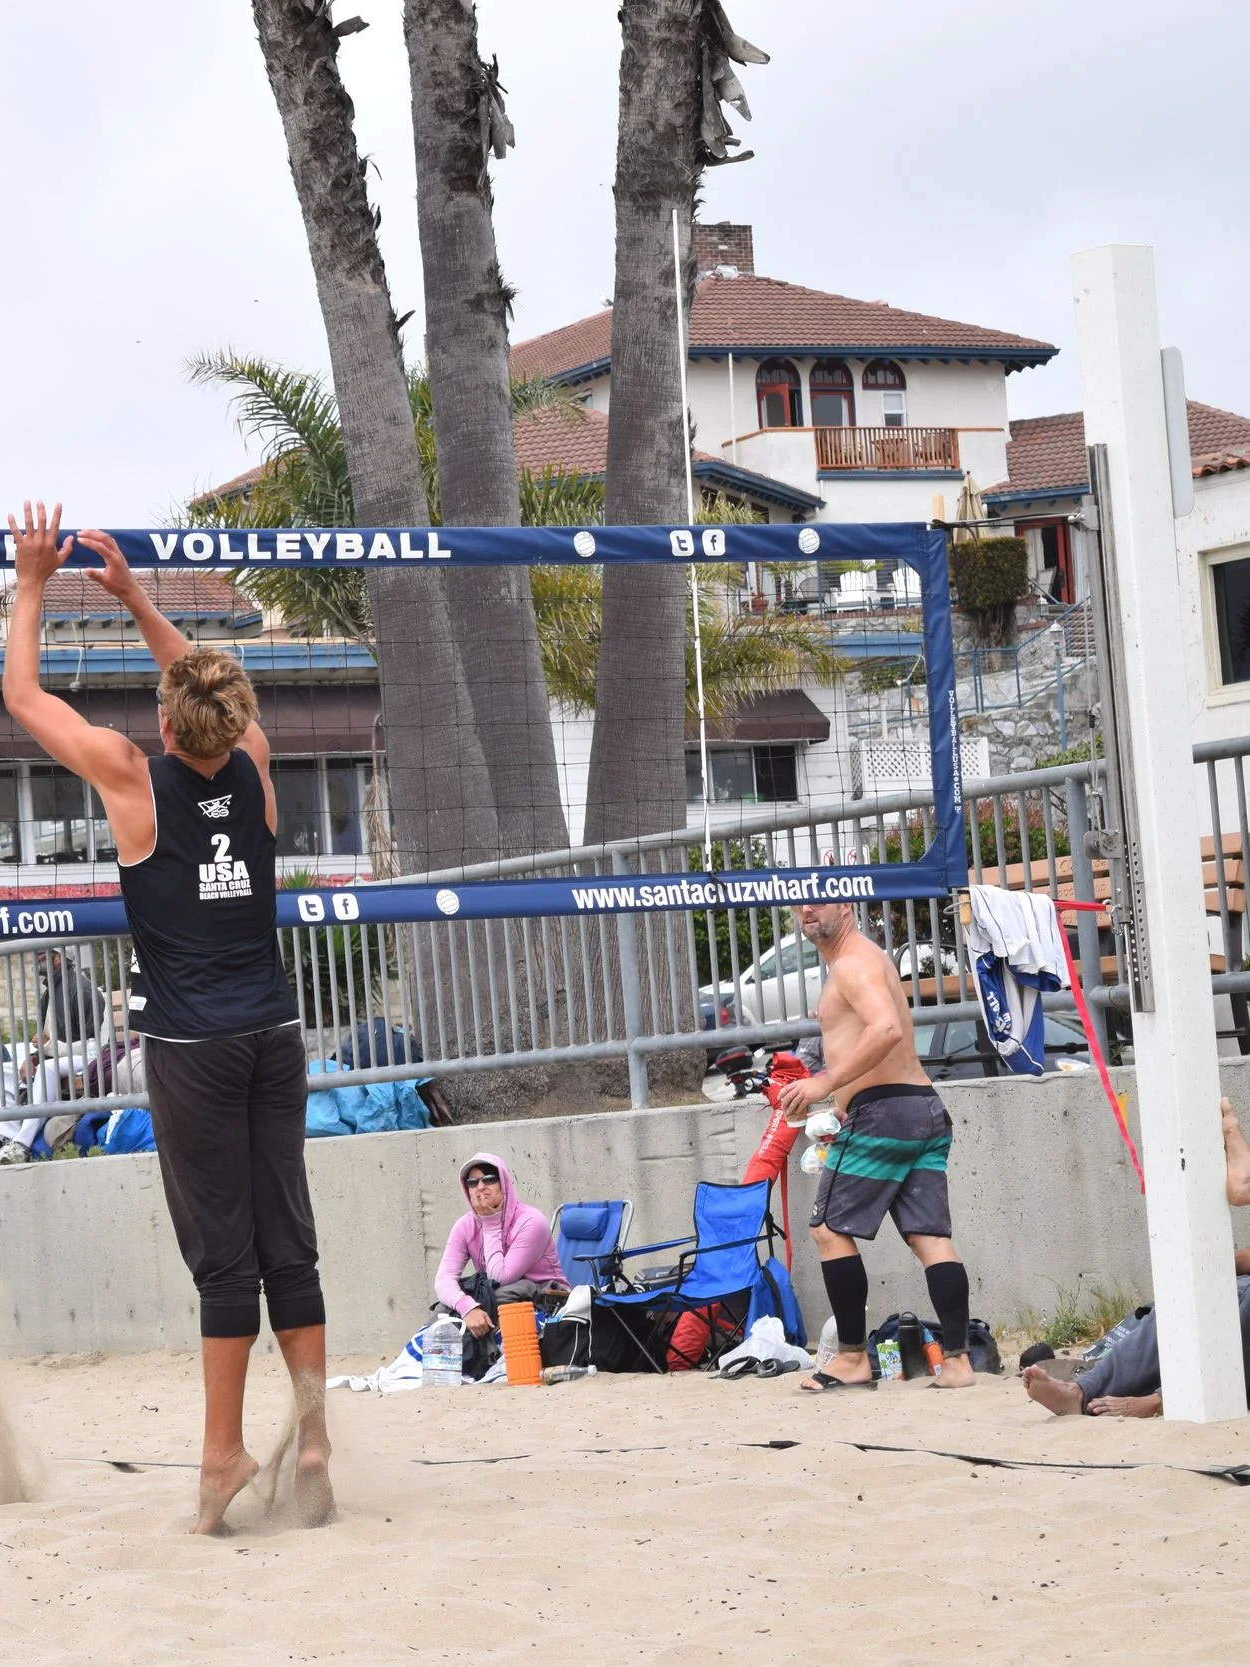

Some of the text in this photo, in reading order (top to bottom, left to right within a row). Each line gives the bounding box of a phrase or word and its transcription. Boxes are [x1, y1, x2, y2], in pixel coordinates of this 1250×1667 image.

[149, 532, 451, 561] VOLLEYBALL
[210, 833, 233, 863] 2
[198, 860, 250, 883] USA
[199, 879, 251, 892] SANTA CRUZ
[199, 888, 253, 900] BEACH VOLLEYBALL
[571, 872, 874, 909] www.santacruzwharf.com
